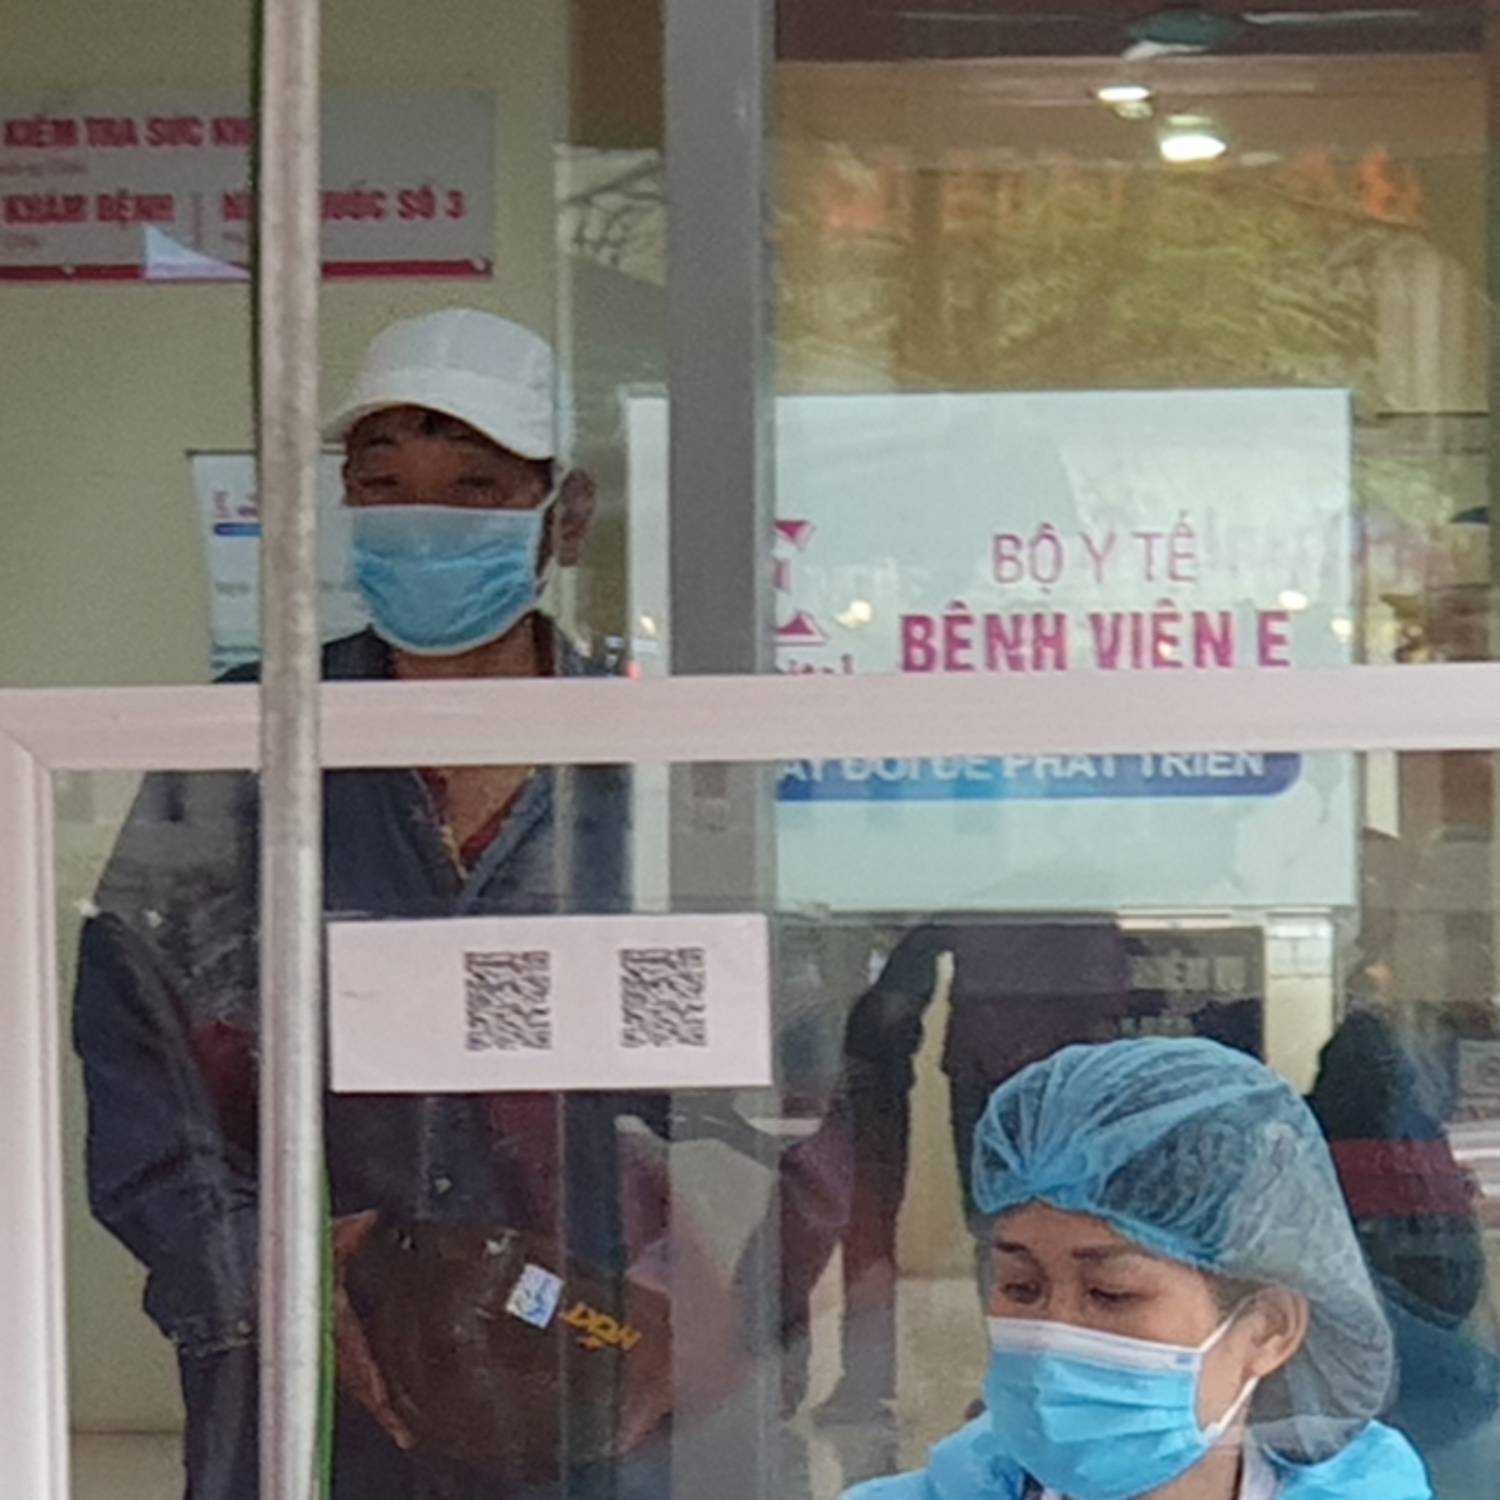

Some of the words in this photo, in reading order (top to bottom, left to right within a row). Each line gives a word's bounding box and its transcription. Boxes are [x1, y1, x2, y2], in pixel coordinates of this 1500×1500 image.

[992, 521, 1065, 594] BỘ
[1083, 532, 1117, 581] Y
[1134, 509, 1198, 583] TẾ
[1257, 608, 1292, 668] E
